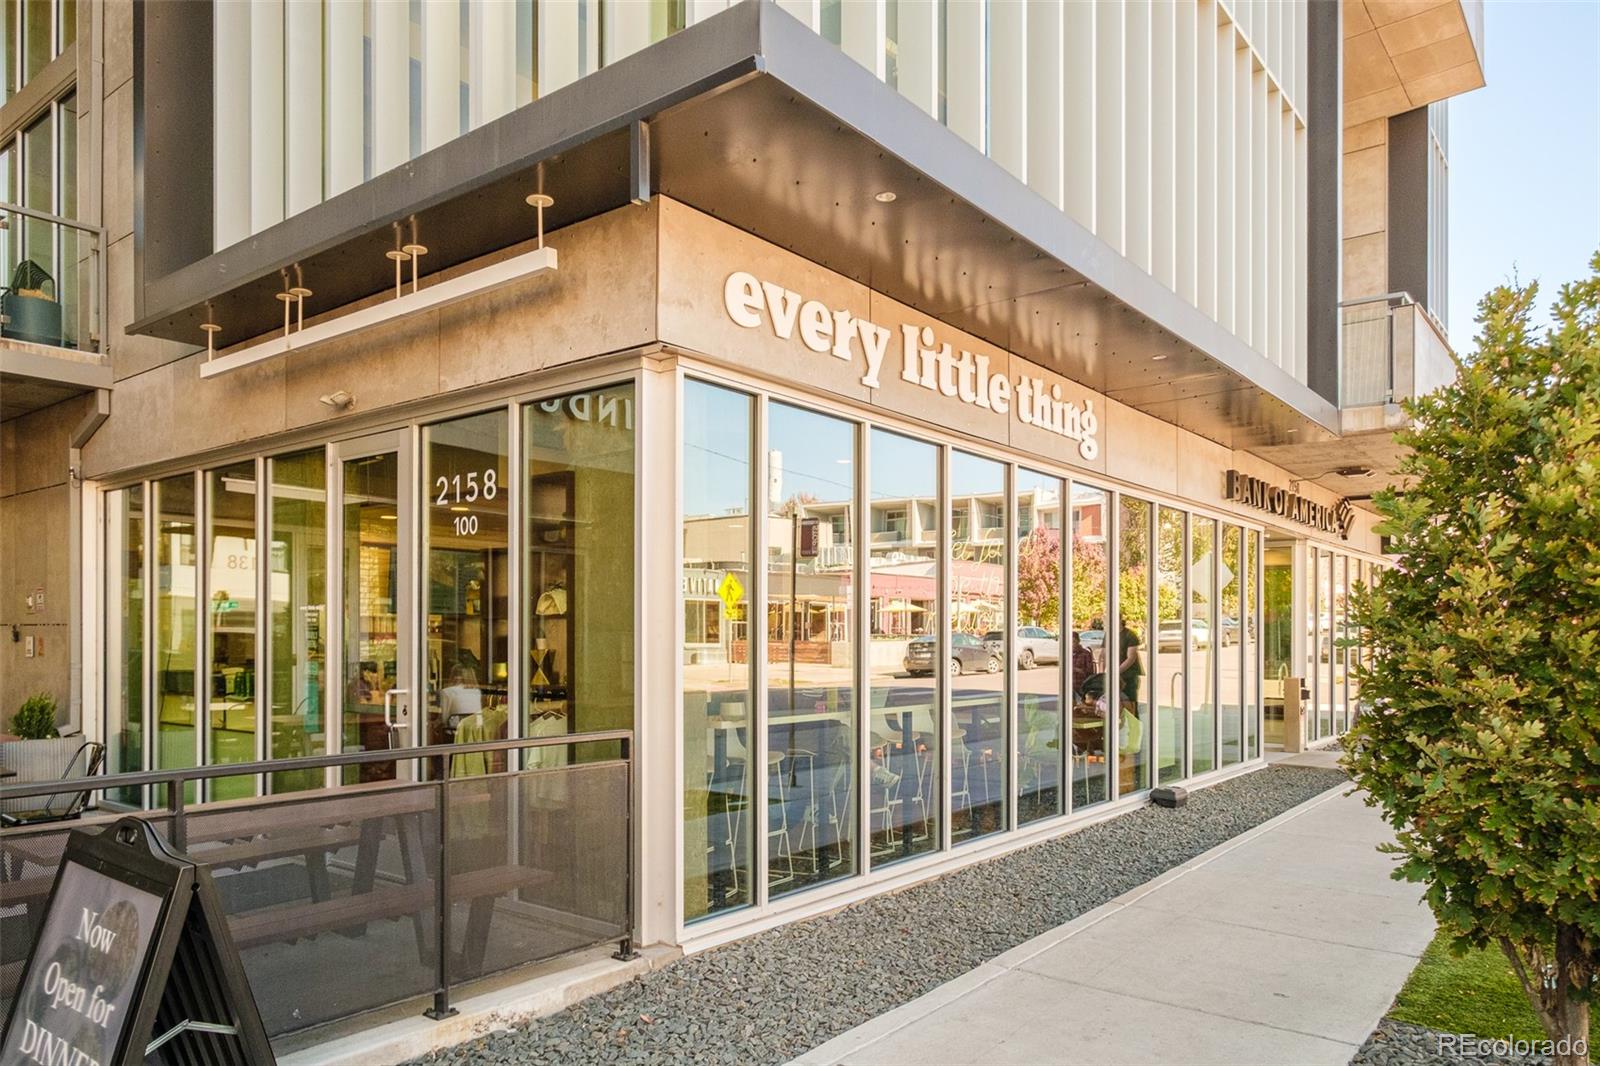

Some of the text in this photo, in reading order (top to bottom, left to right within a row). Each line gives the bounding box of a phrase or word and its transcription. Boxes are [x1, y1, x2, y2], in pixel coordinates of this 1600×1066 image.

[724, 272, 1097, 460] every little thing
[436, 469, 496, 505] 2158
[1227, 470, 1272, 512] BANK
[1289, 495, 1338, 533] AMERICA
[454, 515, 478, 536] 100
[75, 907, 117, 954] Now
[44, 962, 115, 1028] Open for
